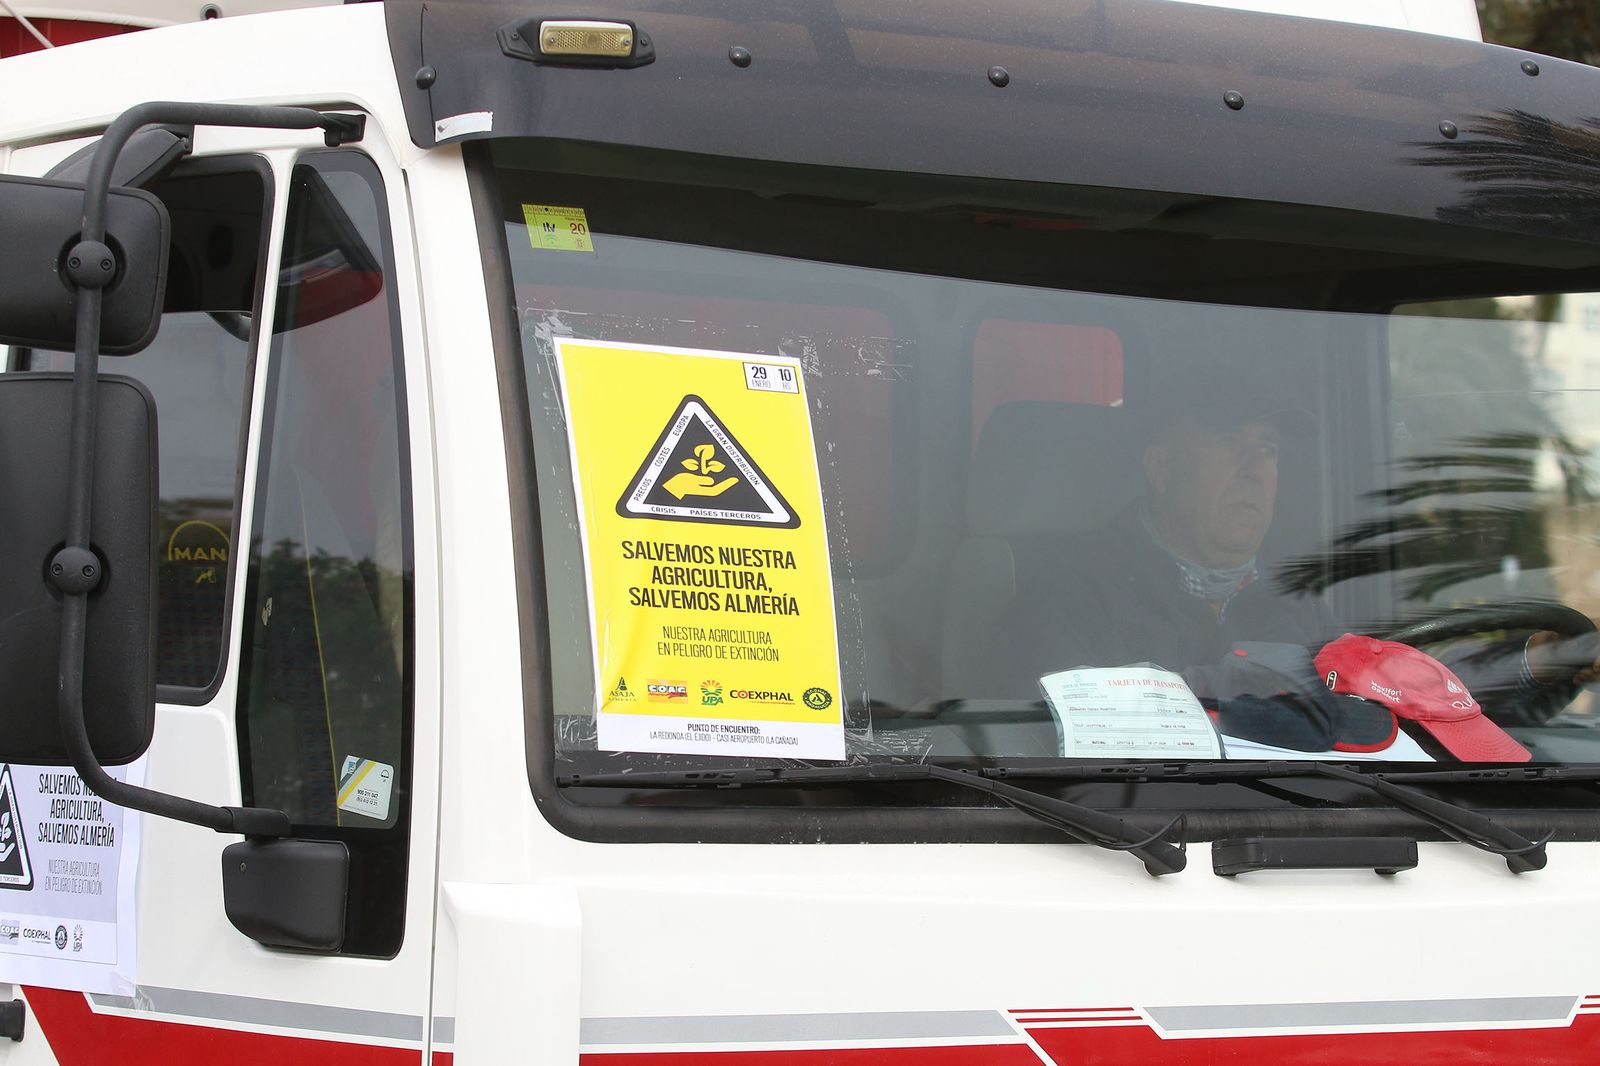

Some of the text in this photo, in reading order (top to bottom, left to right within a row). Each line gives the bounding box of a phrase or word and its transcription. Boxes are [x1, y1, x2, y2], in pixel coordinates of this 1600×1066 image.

[569, 222, 586, 235] 20
[752, 366, 791, 381] 29 10
[672, 415, 689, 436] EUROPA
[705, 420, 714, 428] LA
[712, 429, 728, 445] GRAN
[654, 447, 671, 467] COSTES
[633, 478, 652, 501] PRECIOS
[650, 506, 762, 520] CRISIS PAÍSES TERCEROS
[174, 547, 227, 561] MAN
[621, 540, 797, 569] SALVEMOS NUESTRA
[651, 565, 773, 593] AGRICULTURA,
[628, 587, 800, 616] SALVEMOS ALMERÍA
[662, 625, 772, 645] NUESTRA AGRICULTURA
[657, 642, 779, 661] EN PELIGRO DE EXTINCIÓN
[648, 684, 687, 694] COAG
[1107, 679, 1141, 687] TARJETA
[609, 690, 636, 698] ASAJA
[701, 696, 724, 706] UPA
[729, 689, 794, 702] COEXPHAL
[650, 731, 658, 740] LA
[658, 731, 684, 741] REDONDA
[685, 732, 693, 741] (EL
[716, 734, 729, 743] CASI
[730, 735, 765, 744] AEROPUERTO
[687, 723, 761, 735] PUNTO DE ENCUENTRO:
[39, 773, 80, 796] SALVEMOS
[50, 798, 105, 823] AGRICULTURA,
[38, 822, 115, 847] SALVEMOS ALMERÍA
[48, 859, 100, 877] NUESTRA AGRICULTURA
[45, 876, 52, 891] EN
[52, 877, 71, 893] PELIGRO
[72, 878, 78, 893] DE
[23, 928, 51, 940] COEXPHAL
